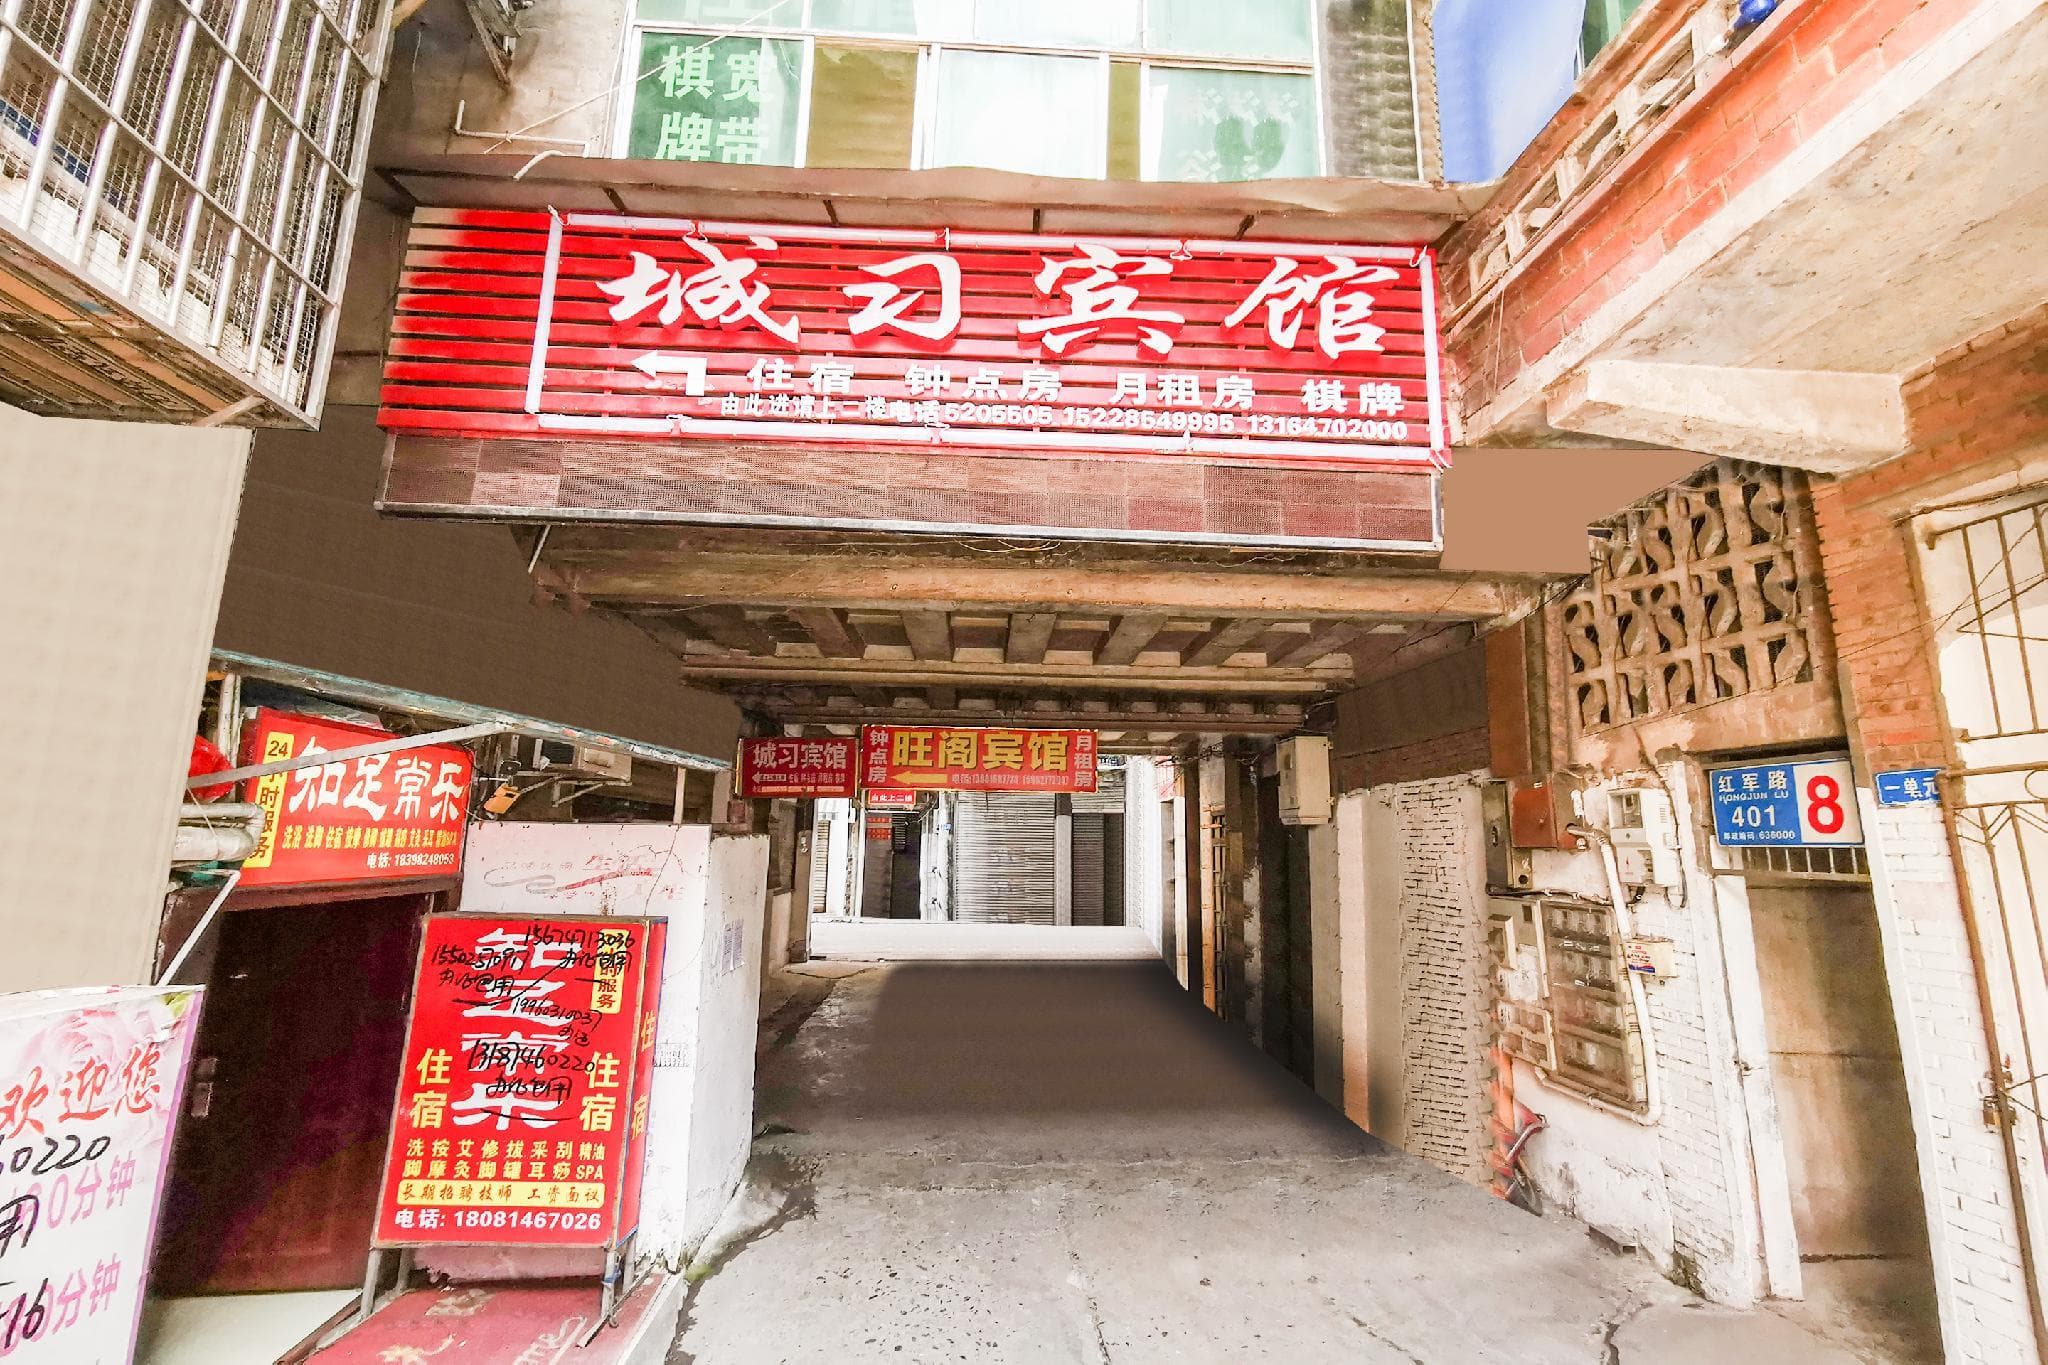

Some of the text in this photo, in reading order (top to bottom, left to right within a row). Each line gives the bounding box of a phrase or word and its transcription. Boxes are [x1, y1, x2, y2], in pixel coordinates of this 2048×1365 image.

[746, 357, 1405, 416] 住宿 钟点房 月租房 棋牌
[1246, 413, 1408, 441] 13164702000
[752, 742, 848, 769] 城习宾馆
[868, 730, 889, 783] 钟点房
[891, 731, 1069, 772] 旺阁宾馆
[1073, 735, 1093, 787] 月租房
[288, 736, 464, 824] 知足常乐
[1718, 769, 1789, 793] 红军路
[1884, 777, 1941, 799] 一单元
[1731, 804, 1776, 829] 401
[1807, 775, 1845, 834] 8
[408, 1047, 453, 1128] 住宿
[579, 1051, 621, 1132] 住宿
[631, 1010, 657, 1141] 住宿
[0, 1134, 111, 1176] 0220
[575, 1164, 604, 1180] SPA
[401, 1183, 602, 1204] 长期招聘技师 工资面议
[395, 1208, 602, 1230] 电话: 18081467026
